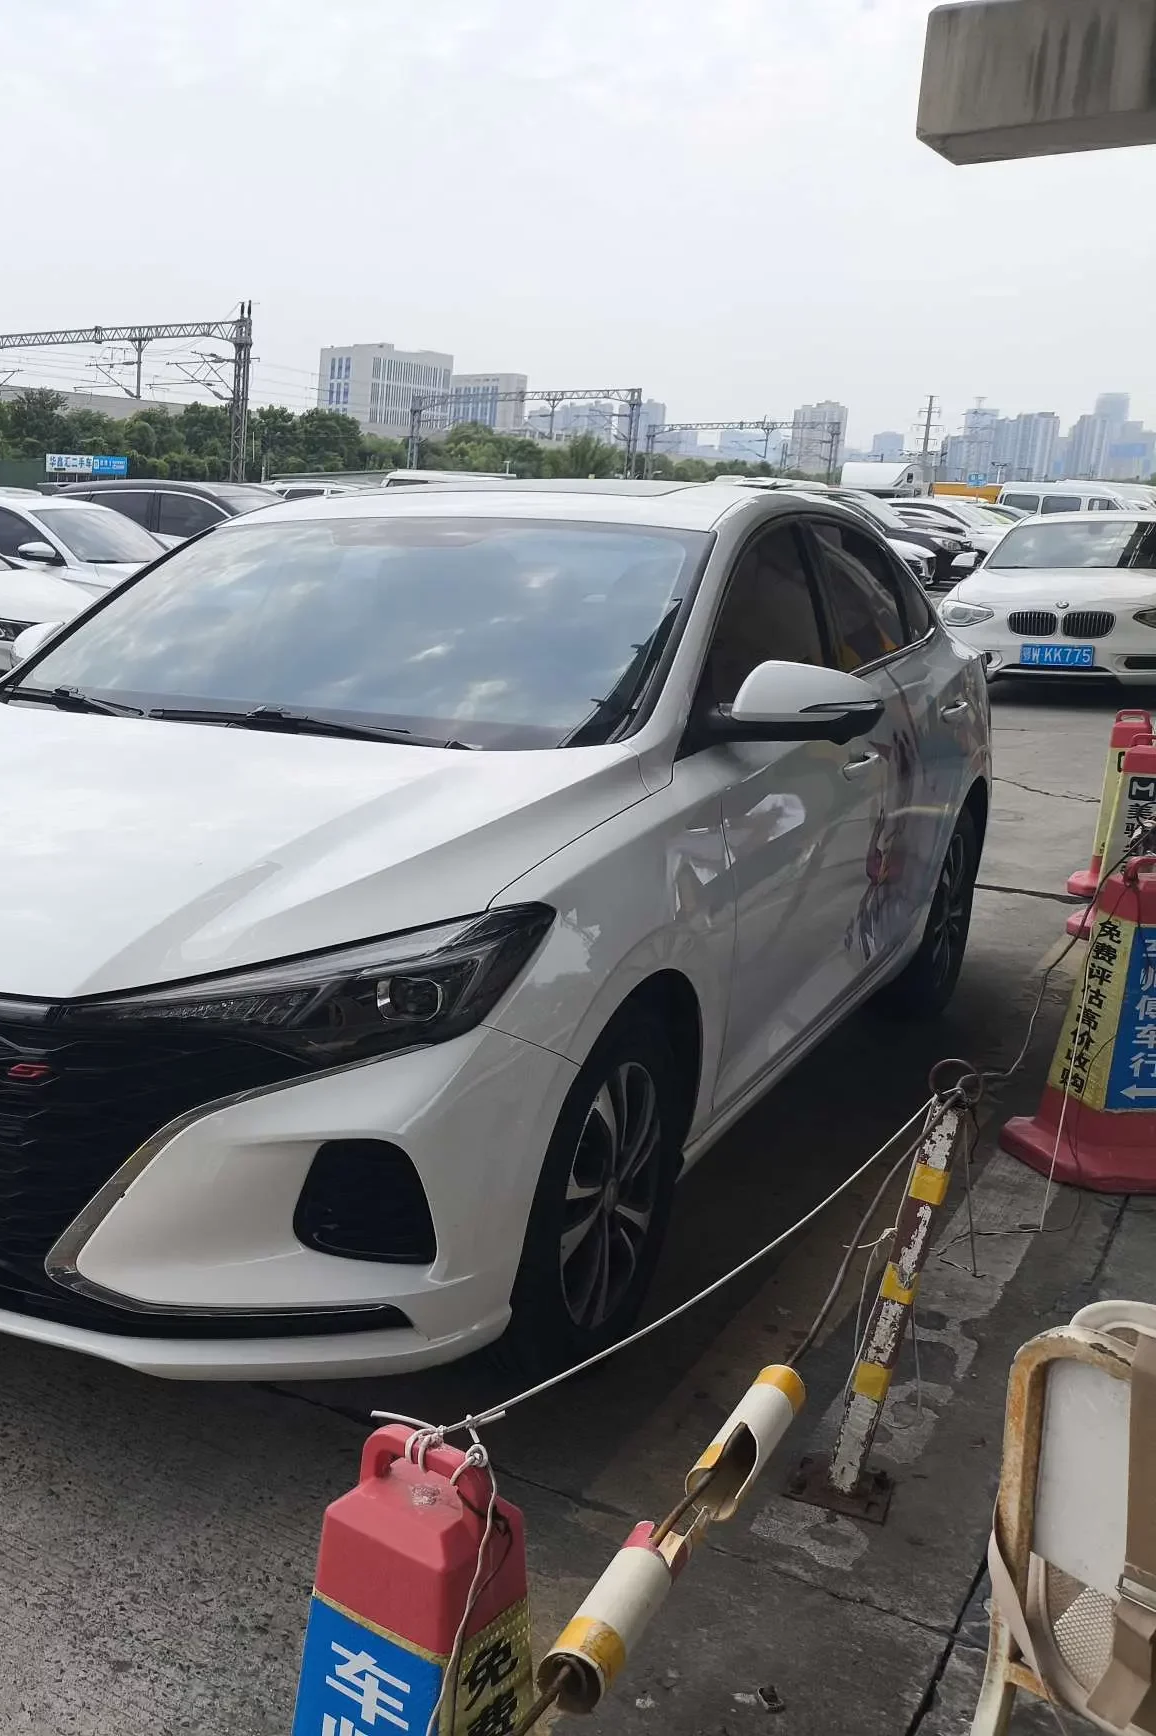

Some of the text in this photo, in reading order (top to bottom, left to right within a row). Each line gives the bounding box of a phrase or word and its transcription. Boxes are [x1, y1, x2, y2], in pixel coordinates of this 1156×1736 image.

[1060, 920, 1122, 1094] 免费评估高价收购
